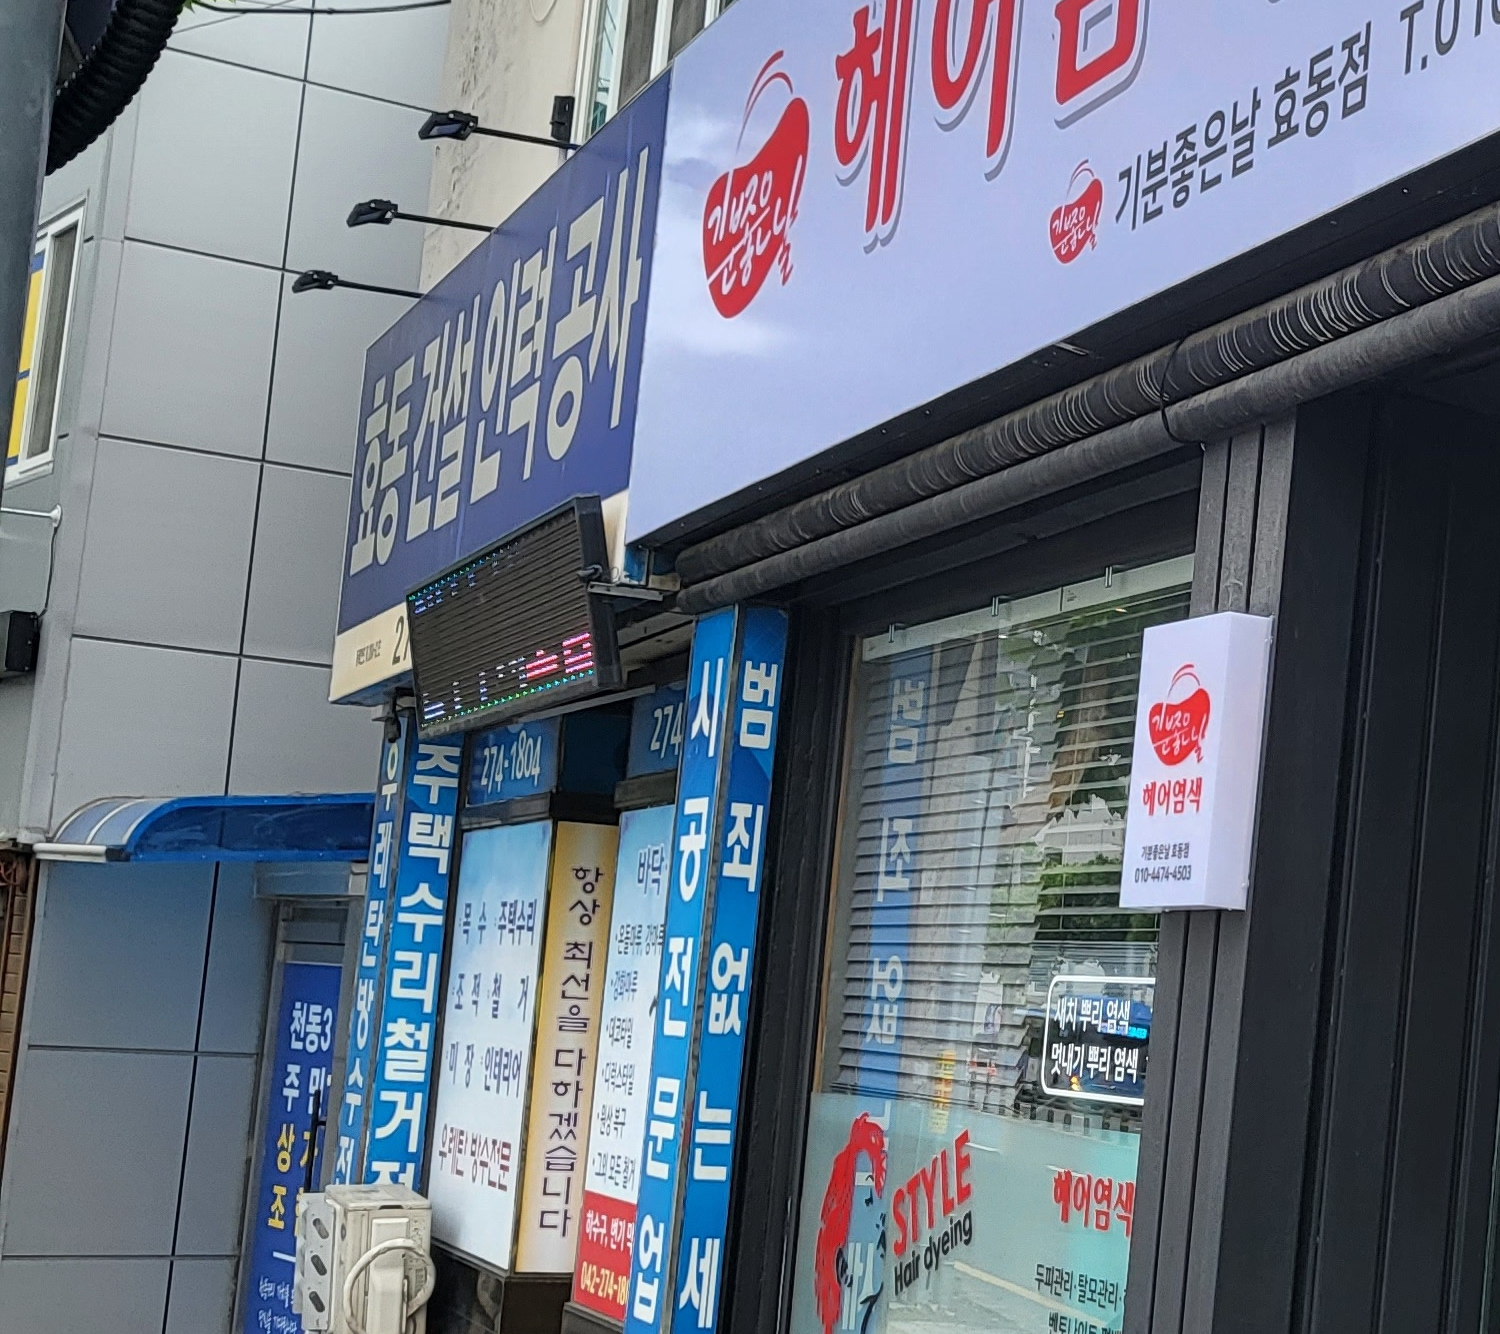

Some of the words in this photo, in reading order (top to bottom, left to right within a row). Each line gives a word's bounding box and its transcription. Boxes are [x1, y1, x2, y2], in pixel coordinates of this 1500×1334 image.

[1114, 86, 1261, 230] 기분좋은날
[1267, 21, 1373, 151] 효동점
[650, 701, 684, 759] 274
[480, 730, 542, 795] 274-1804
[1142, 777, 1203, 816] 헤어염색
[1134, 864, 1192, 884] 010-4474-4503
[1140, 844, 1171, 861] 기분좋은날
[1171, 842, 1190, 860] 효동점
[497, 898, 538, 947] 주택수리
[569, 866, 604, 926] 항상
[557, 940, 594, 1033] 최선을
[1053, 997, 1078, 1033] 새치
[1080, 999, 1103, 1033] 뿌리
[1106, 999, 1131, 1035] 염색
[484, 1046, 523, 1098] 인테리어
[1050, 1042, 1085, 1078] 멋내기
[1087, 1045, 1111, 1081] 뿌리
[1114, 1047, 1139, 1084] 염색
[439, 1123, 468, 1178] 우레탄
[470, 1132, 512, 1192] 방수전문
[539, 1047, 587, 1238] 다하겠습니다
[892, 1129, 972, 1258] STYLE
[1053, 1169, 1135, 1238] 헤어염색
[894, 1249, 921, 1296] Hair
[924, 1209, 973, 1271] dyeing
[580, 1260, 629, 1306] 042-274-18
